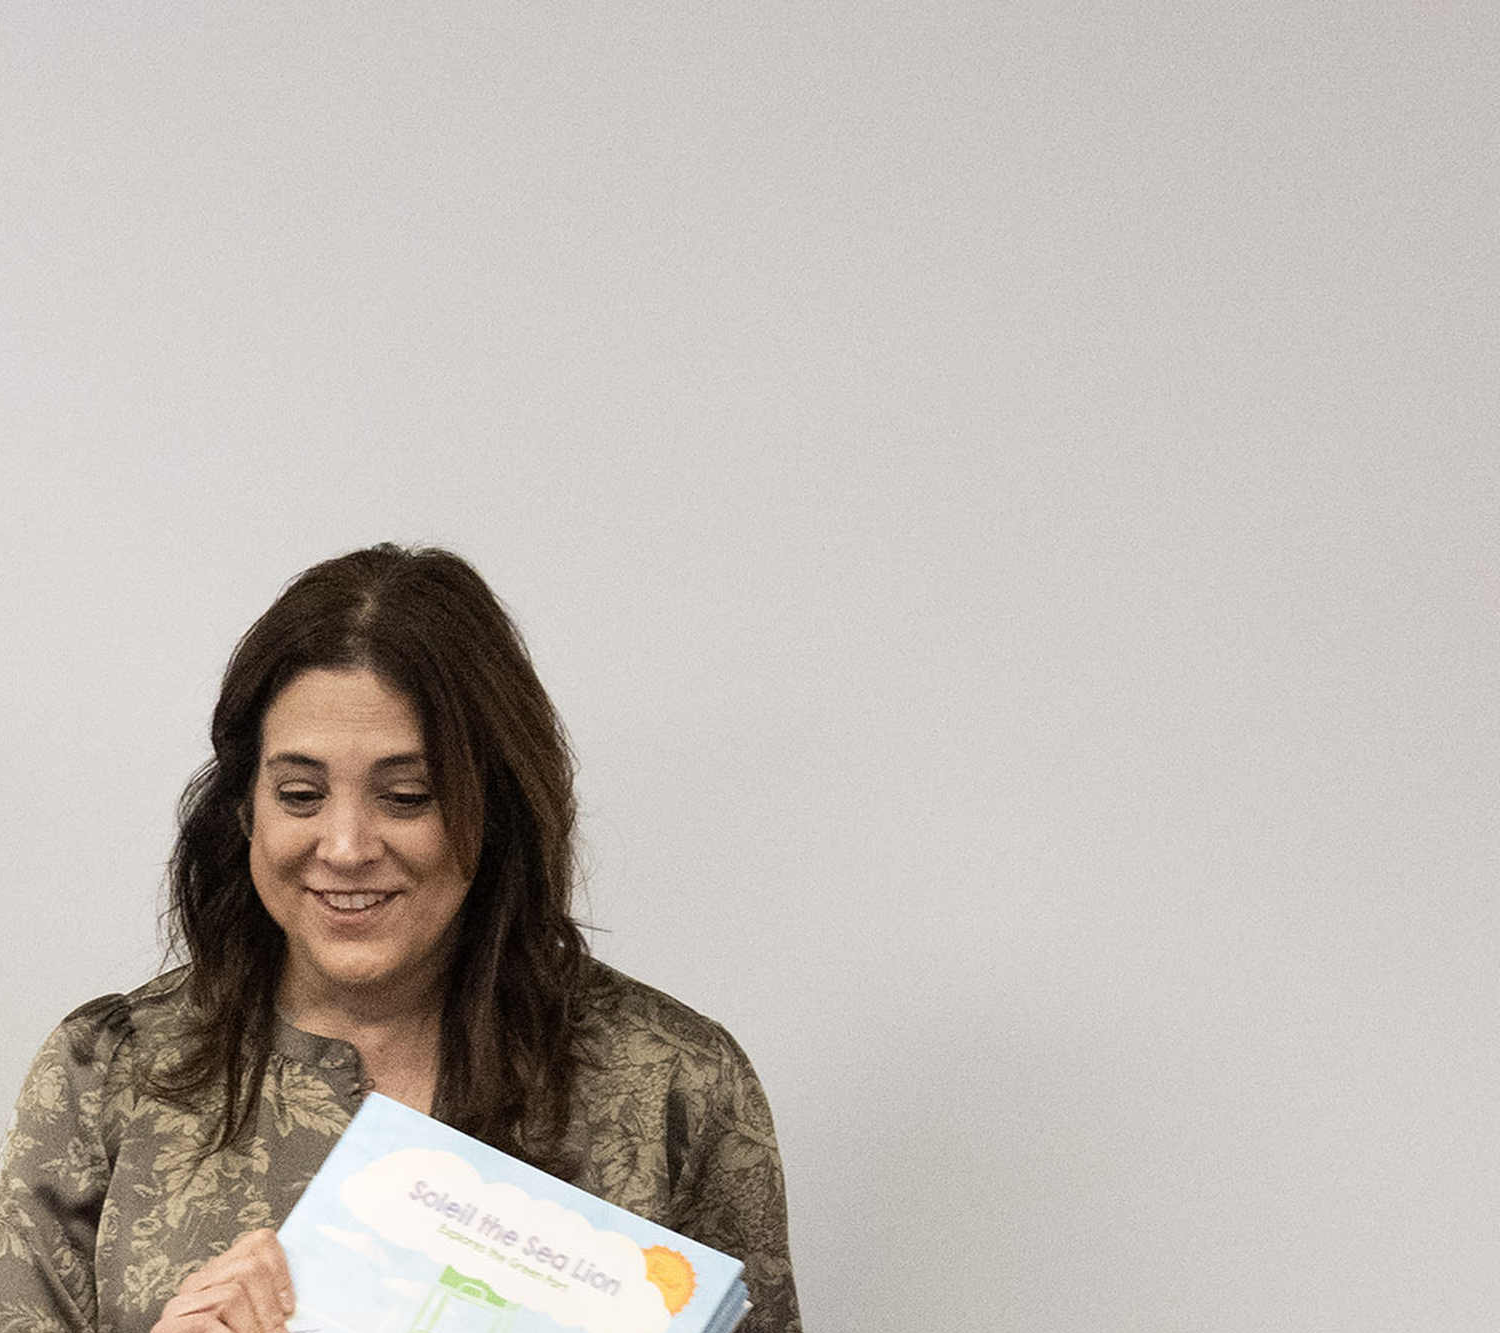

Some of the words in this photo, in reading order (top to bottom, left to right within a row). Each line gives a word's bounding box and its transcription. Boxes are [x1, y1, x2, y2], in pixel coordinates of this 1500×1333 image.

[408, 1179, 479, 1226] Soleil
[477, 1213, 520, 1247] the
[522, 1235, 570, 1271] Sea
[570, 1257, 623, 1297] Lion
